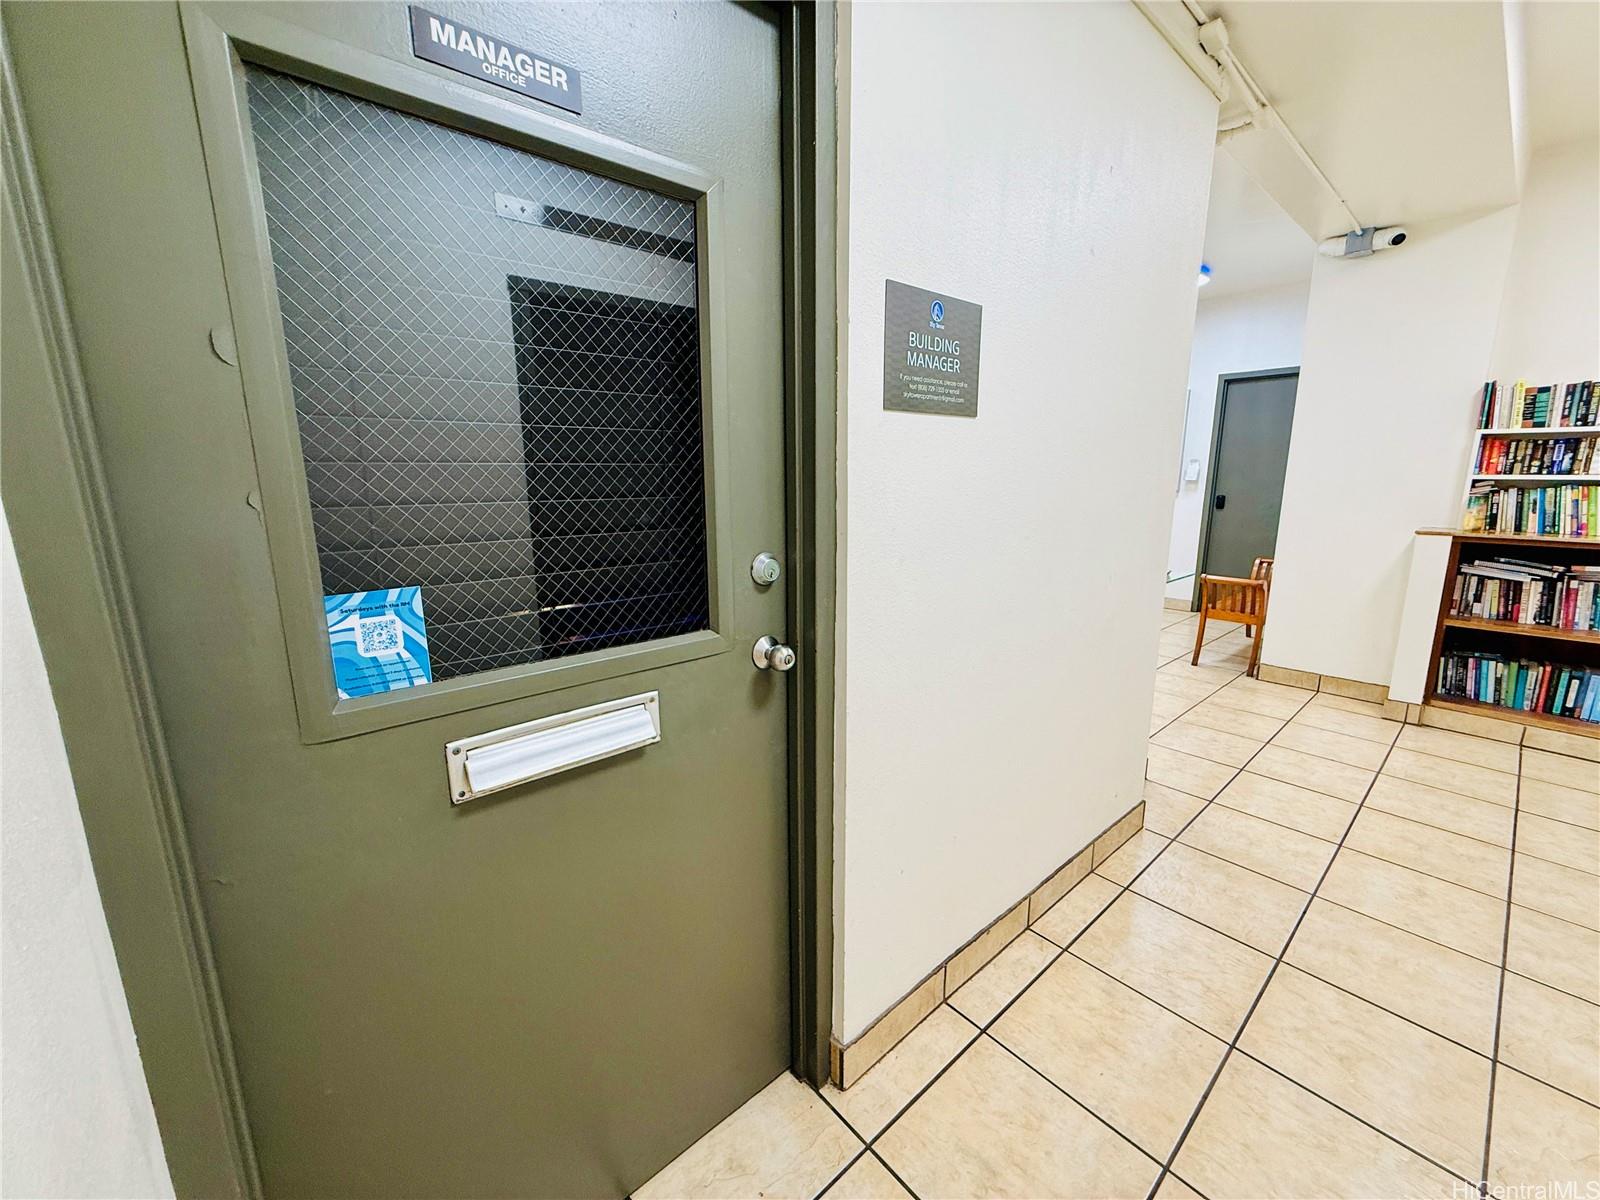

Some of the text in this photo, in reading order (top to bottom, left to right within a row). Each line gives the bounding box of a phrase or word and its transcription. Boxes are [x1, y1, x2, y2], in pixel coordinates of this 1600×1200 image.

[429, 17, 569, 92] MANAGER
[482, 62, 527, 88] OFFICE
[909, 331, 960, 356] BUILDING
[907, 350, 961, 373] MANAGER
